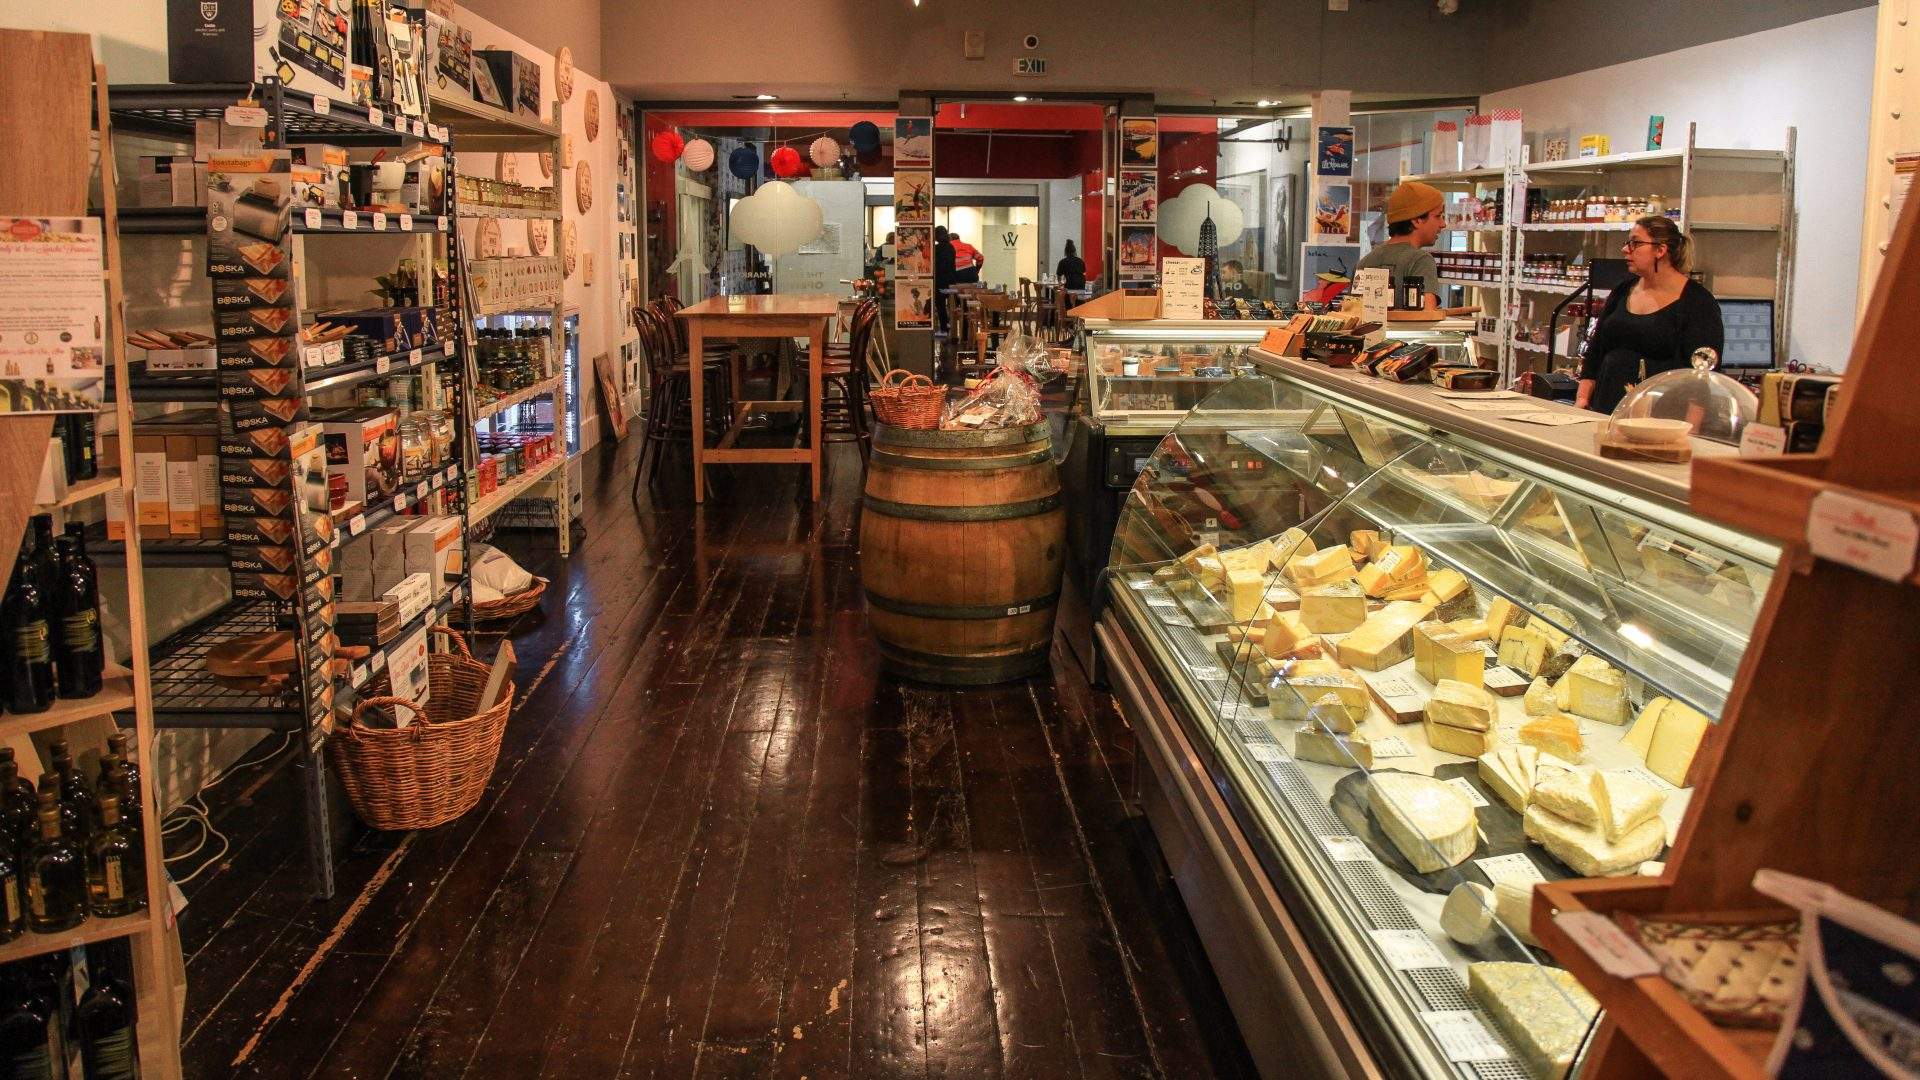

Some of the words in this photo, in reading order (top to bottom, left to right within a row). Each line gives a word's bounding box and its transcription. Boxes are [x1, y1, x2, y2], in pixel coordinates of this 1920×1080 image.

[1018, 58, 1046, 73] EXIT
[211, 265, 244, 273] BOSKA
[217, 296, 250, 304] BOSKA
[222, 326, 255, 336] BOSKA
[221, 357, 254, 366] BOSKA
[222, 386, 254, 395] BOSKA
[237, 416, 268, 428] BOSKA
[221, 445, 253, 454] BOSKA
[223, 475, 254, 483] BOSKA
[224, 504, 255, 513] BOSKA
[229, 533, 259, 541] BOSKA
[232, 560, 262, 569] BOSKA
[235, 589, 266, 598] BOSKA
